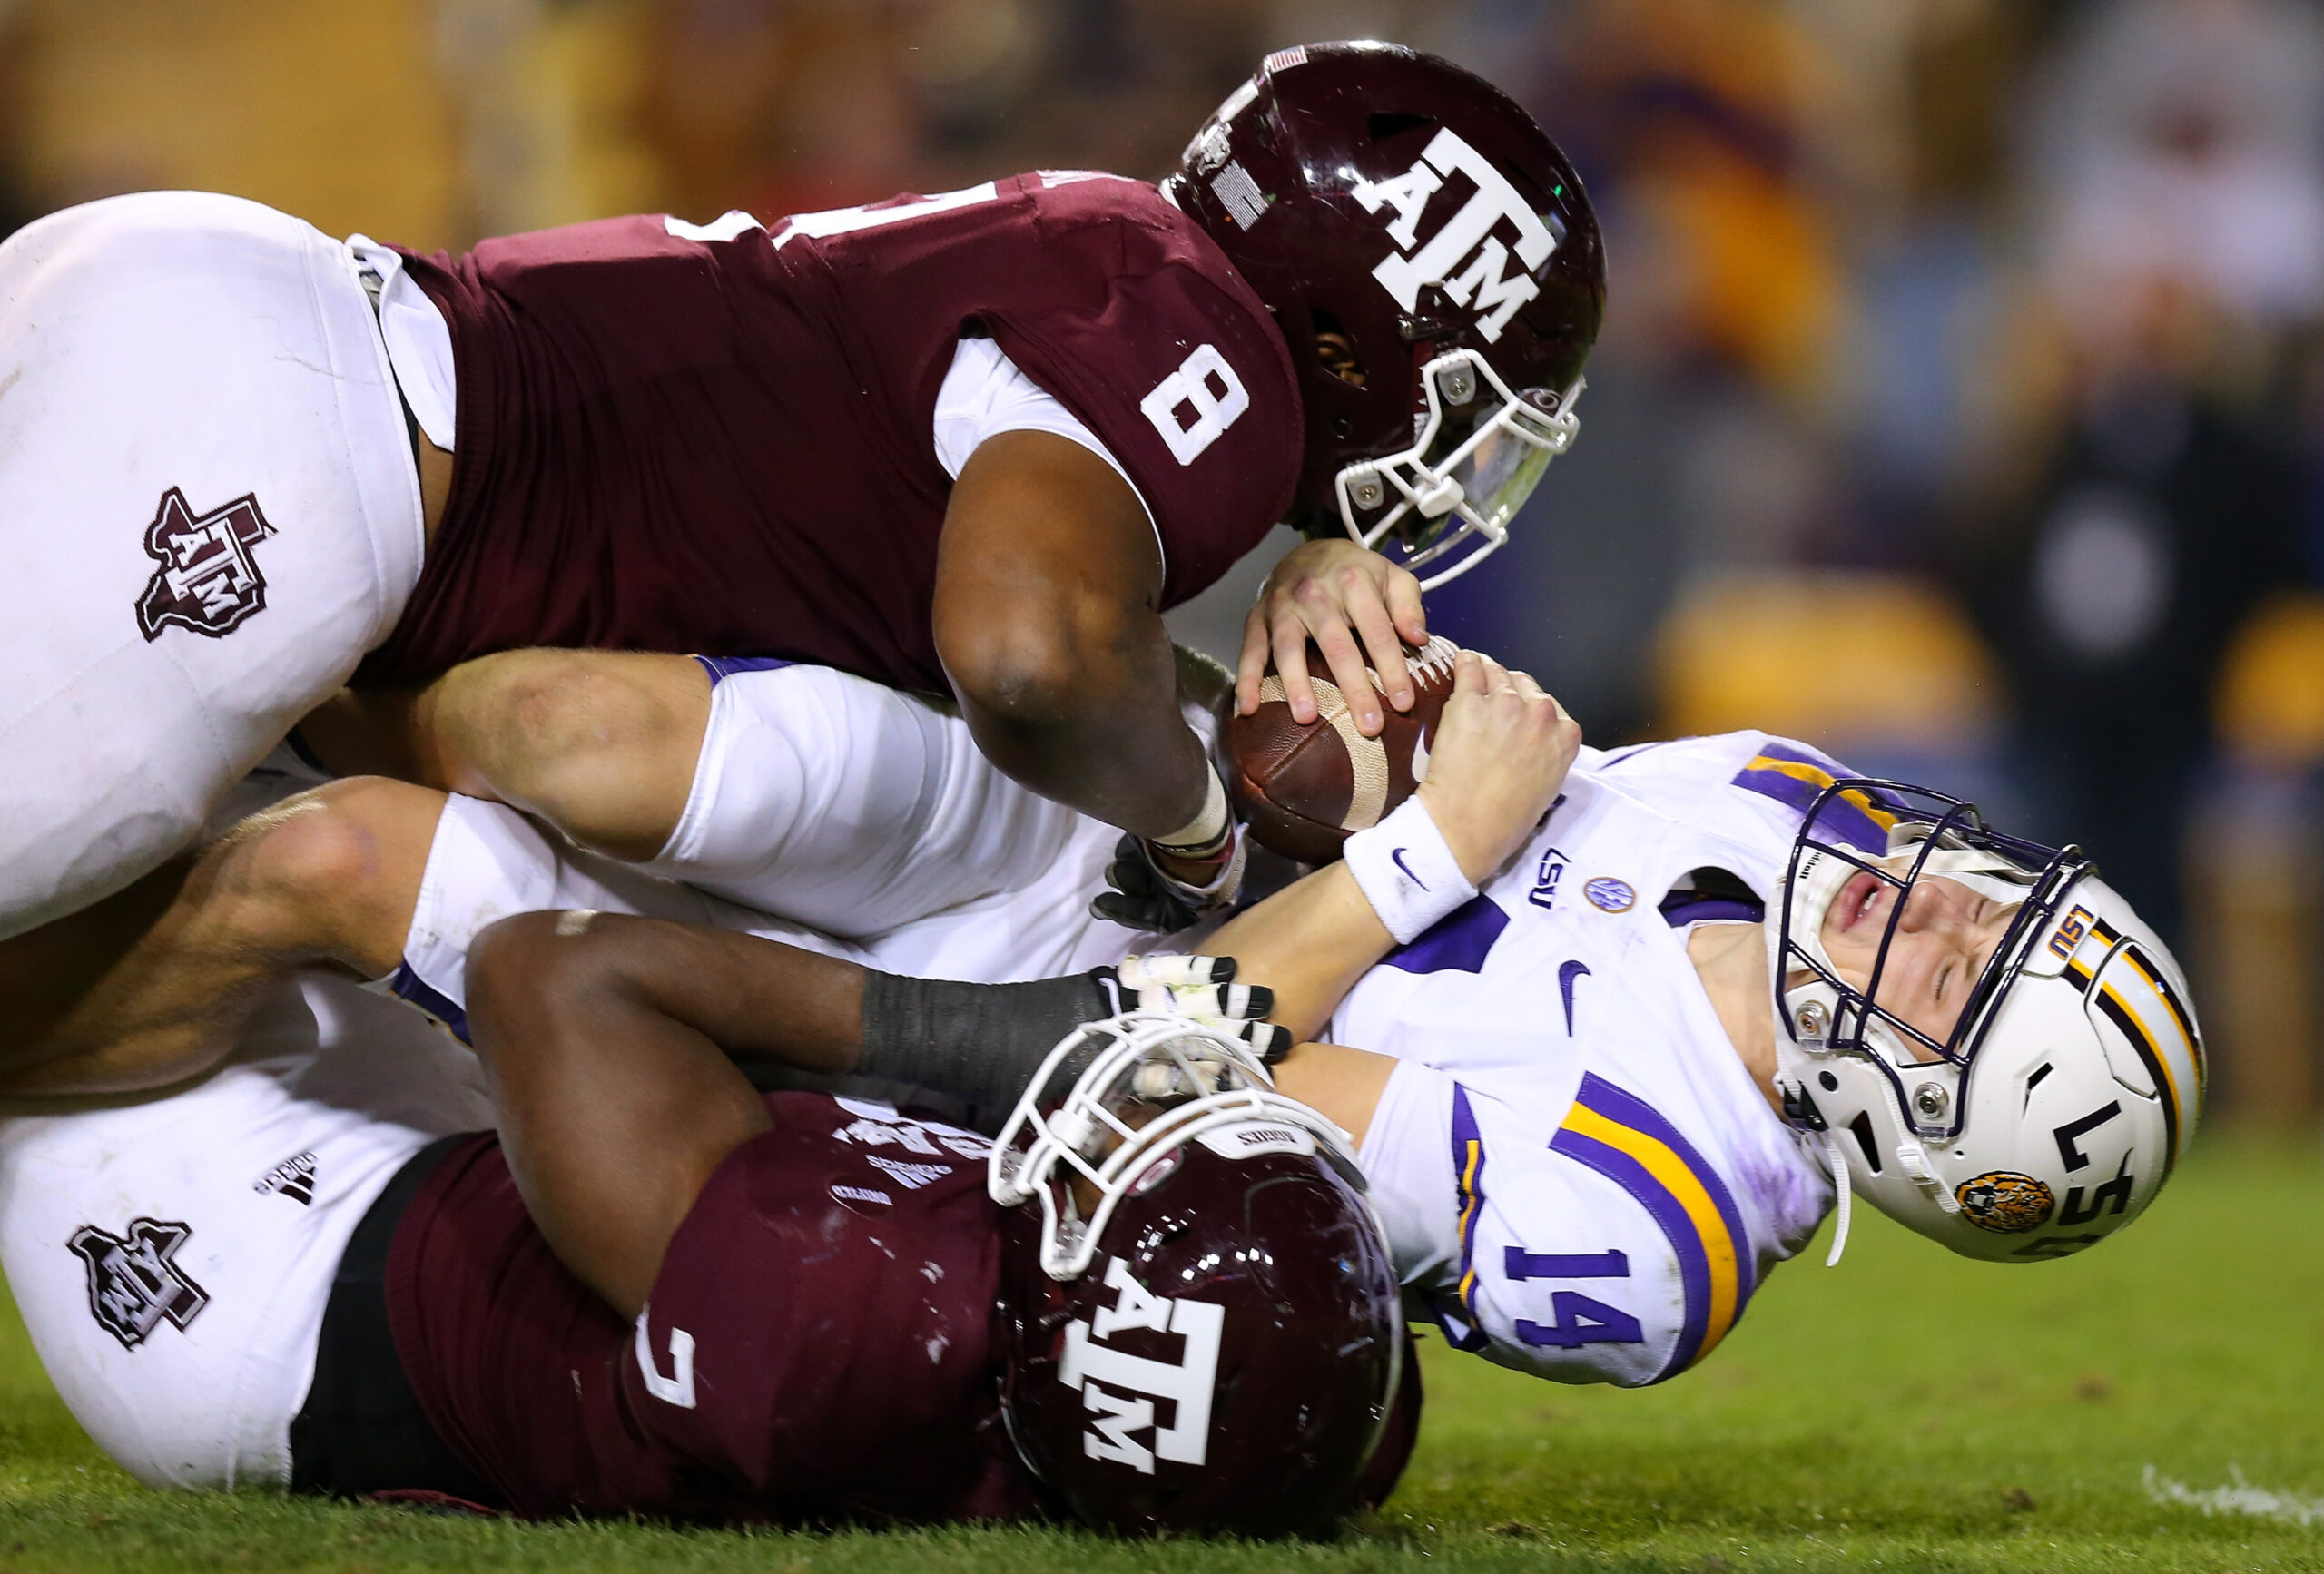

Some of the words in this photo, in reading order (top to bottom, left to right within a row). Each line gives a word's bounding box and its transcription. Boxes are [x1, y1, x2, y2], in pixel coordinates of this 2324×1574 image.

[1139, 343, 1251, 467] 8
[1529, 848, 1571, 910] LSU
[2046, 903, 2095, 962] LSU
[1236, 1130, 1298, 1146] AGGIES
[1504, 1244, 1645, 1350] 14
[635, 1302, 697, 1409] 2
